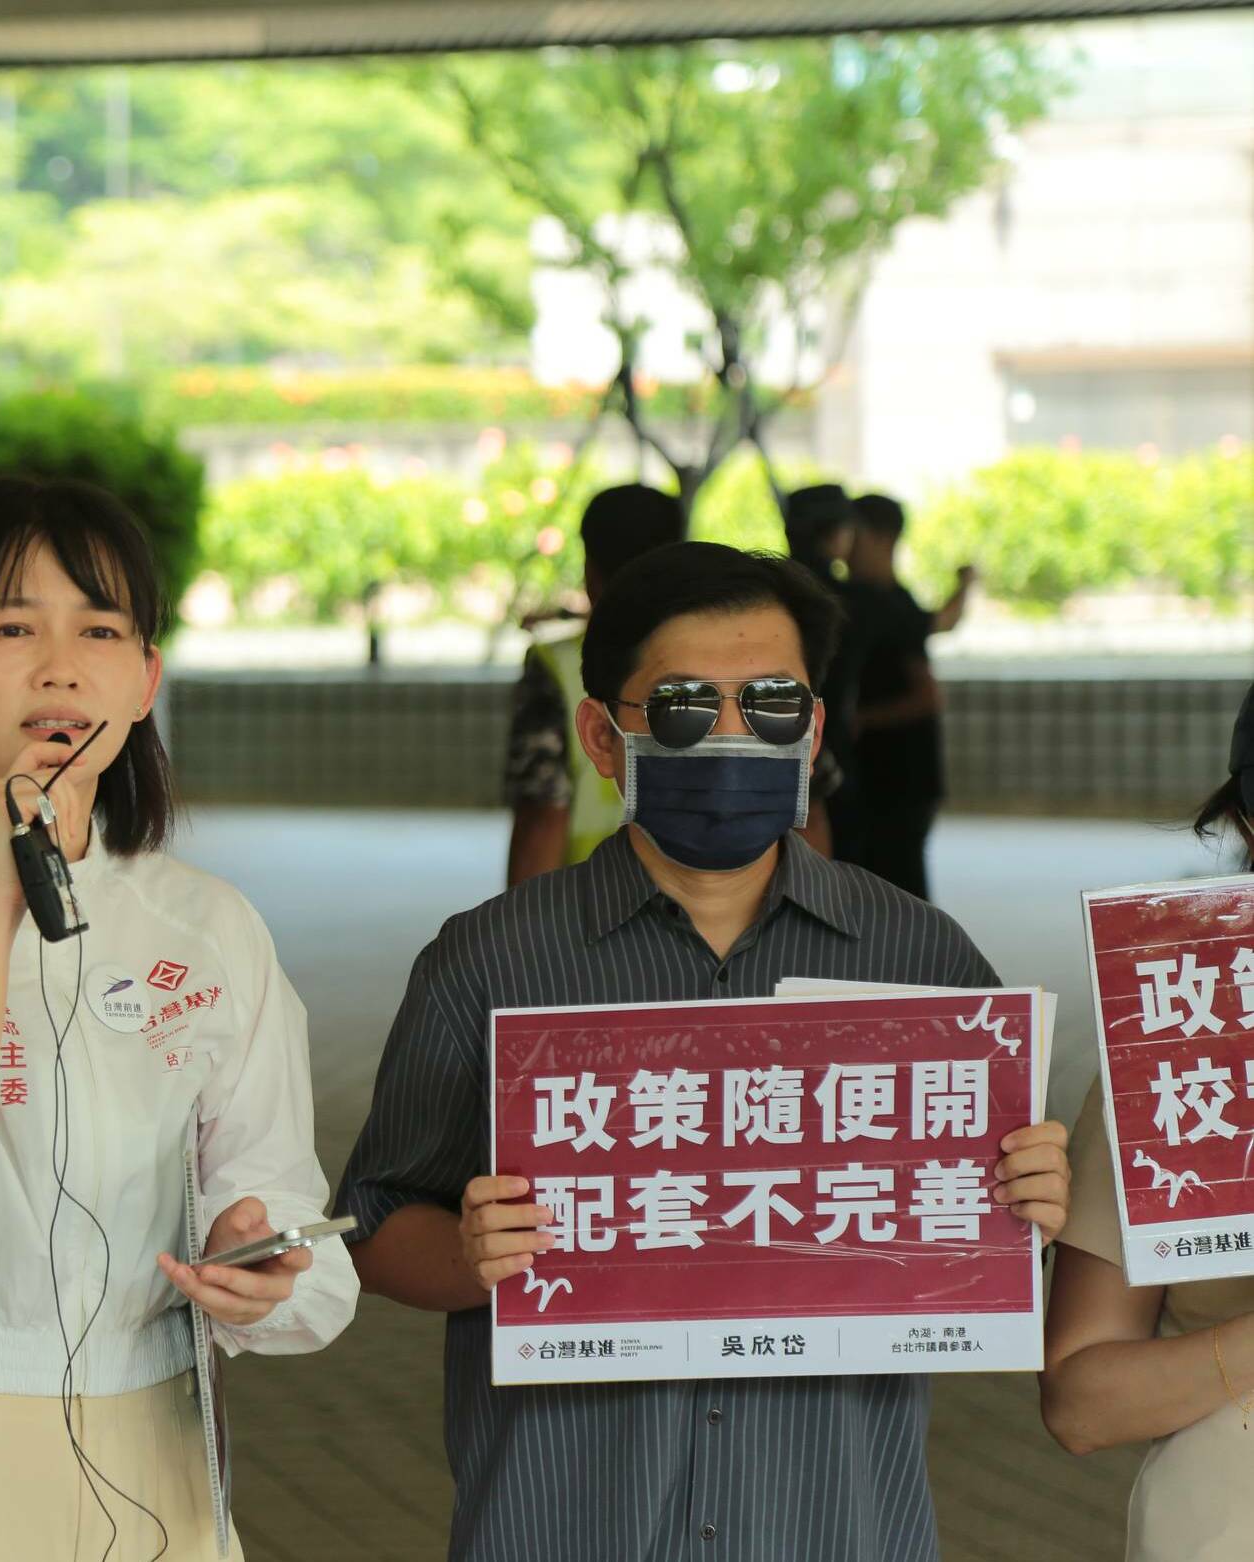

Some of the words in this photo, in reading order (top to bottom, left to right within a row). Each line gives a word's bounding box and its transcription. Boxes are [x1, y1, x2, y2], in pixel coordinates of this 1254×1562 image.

[532, 1059, 990, 1153] 政策隨便開
[533, 1159, 992, 1255] 配套不完善
[1175, 1231, 1254, 1257] 台灣基進
[538, 1339, 616, 1361] 台灣基進
[721, 1334, 806, 1358] 吳欣岱
[891, 1340, 985, 1353] 台北市議員參選人
